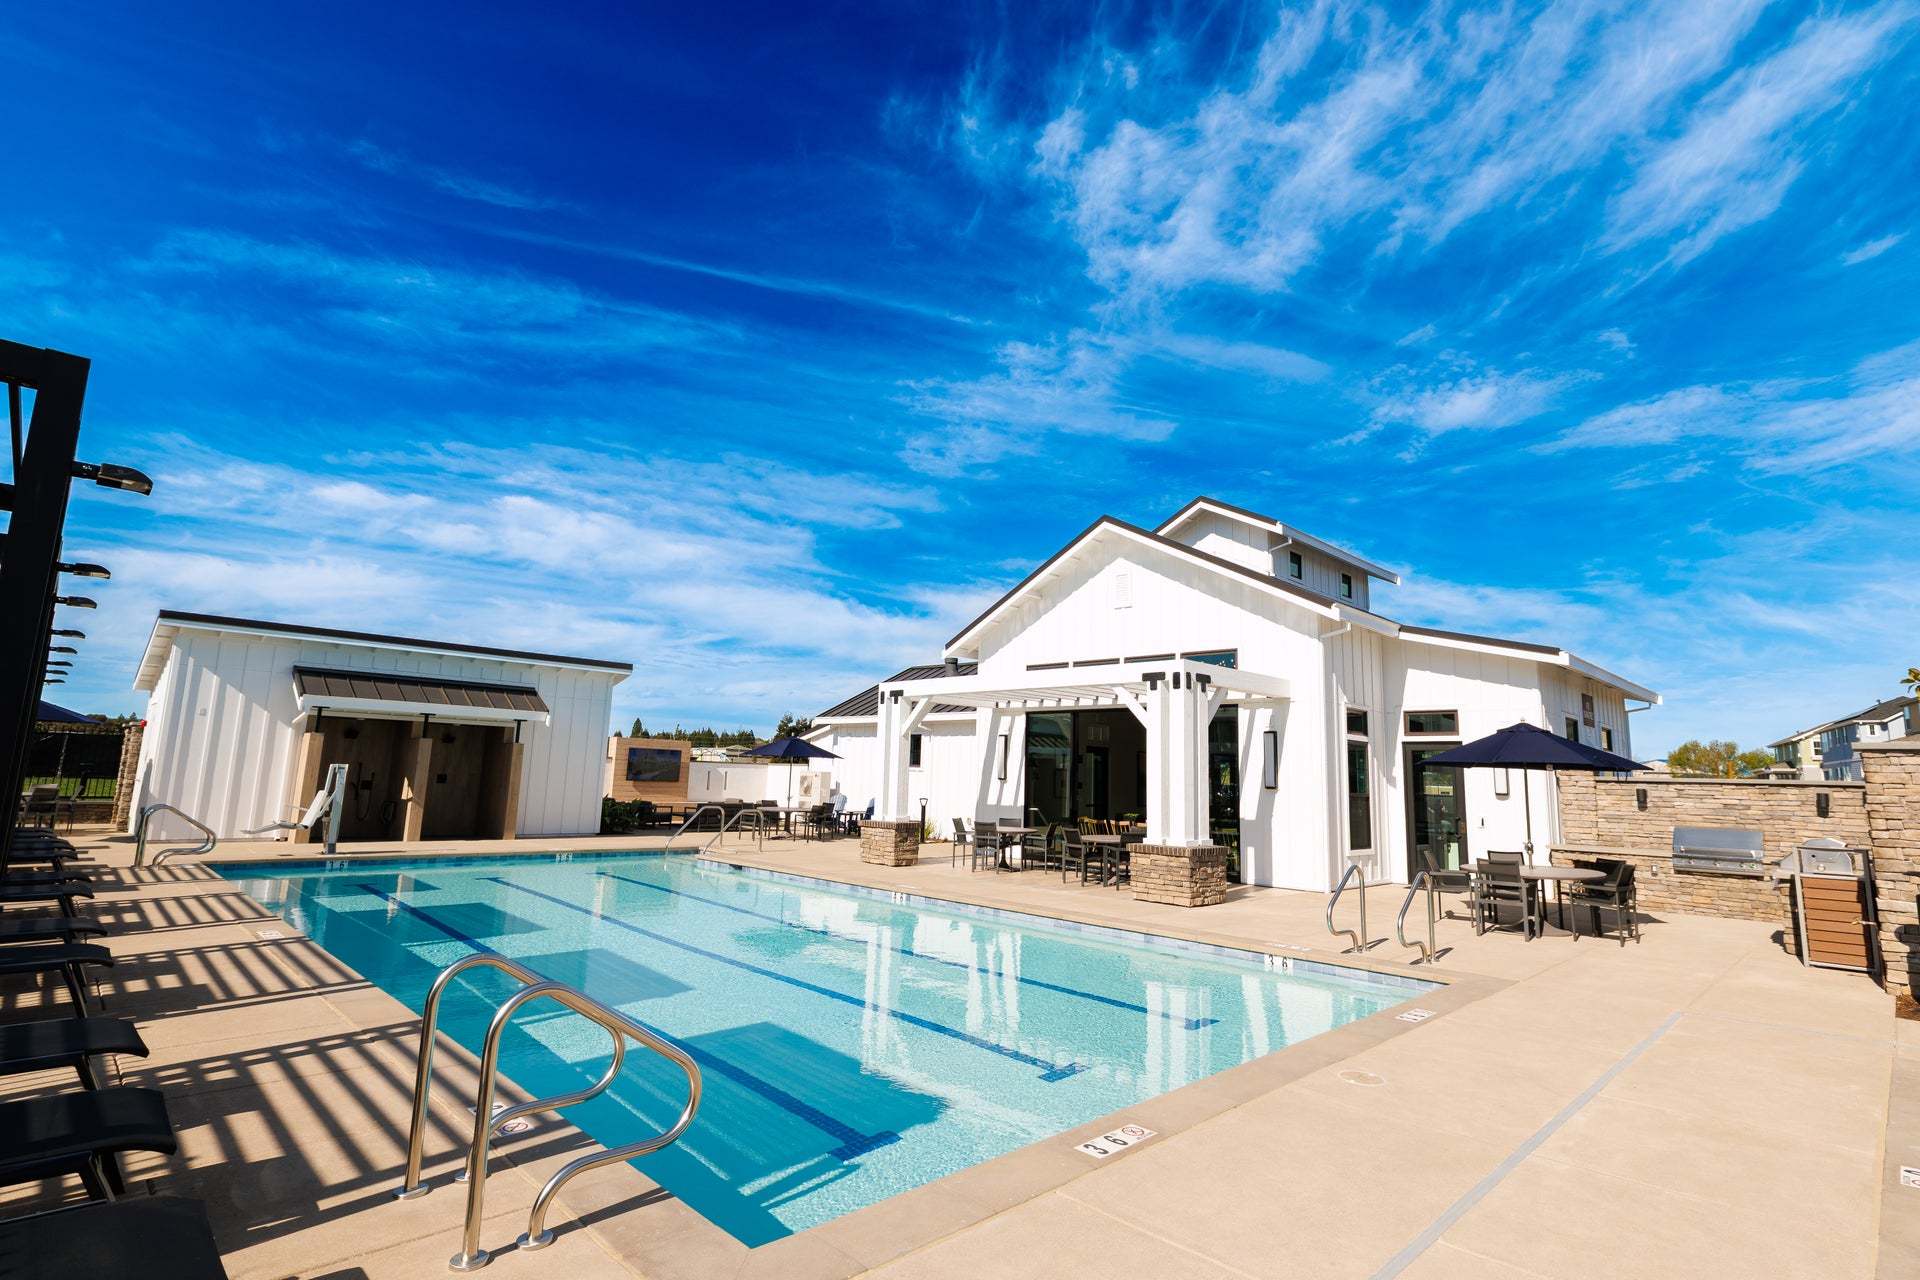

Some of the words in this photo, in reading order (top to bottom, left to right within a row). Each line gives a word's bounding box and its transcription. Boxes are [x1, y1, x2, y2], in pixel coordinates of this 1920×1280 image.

[1268, 954, 1274, 967] 3
[1281, 956, 1288, 969] 6
[1083, 1143, 1109, 1155] 3
[1103, 1135, 1129, 1146] 6
